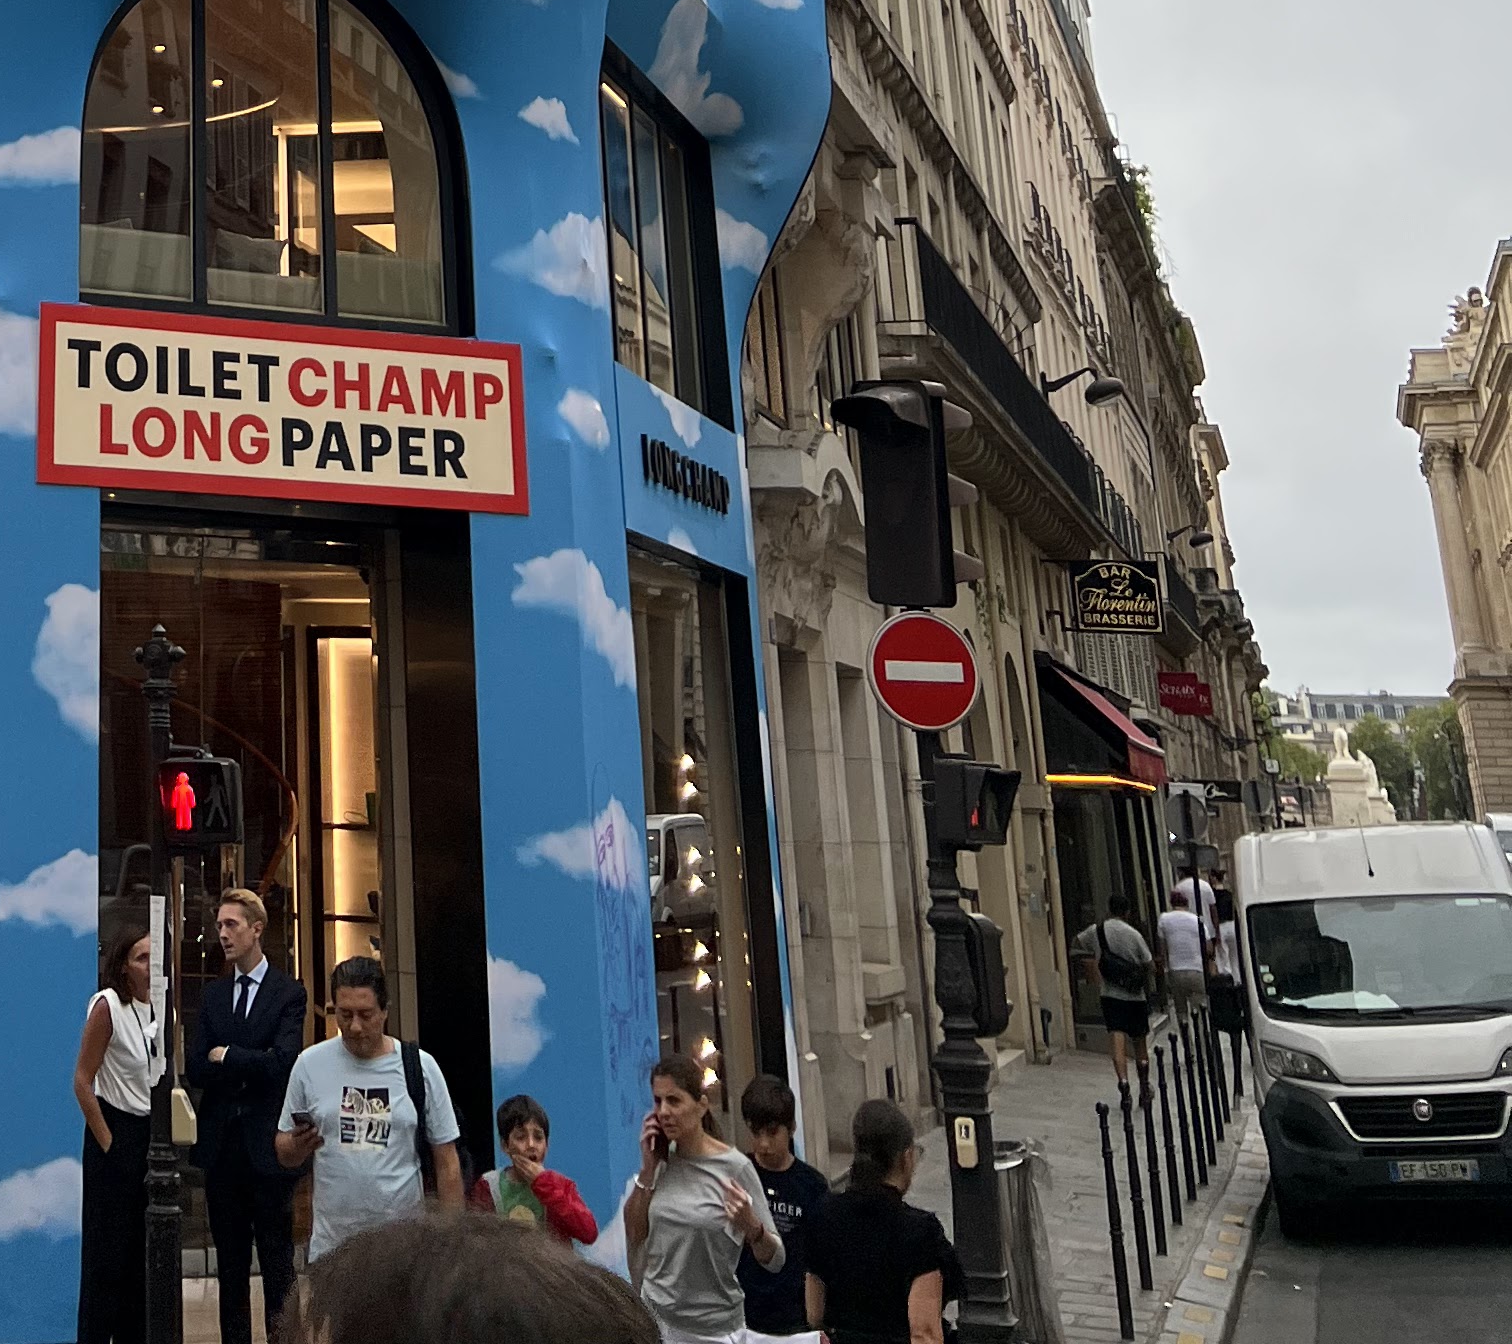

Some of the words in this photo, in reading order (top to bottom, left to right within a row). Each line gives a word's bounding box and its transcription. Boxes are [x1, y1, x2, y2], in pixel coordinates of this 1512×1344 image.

[640, 433, 731, 515] LONGCHAMP
[1098, 566, 1131, 579] BAR
[1109, 578, 1133, 597] Le
[1080, 587, 1156, 612] Florentin
[1083, 612, 1156, 626] BRASSERIE
